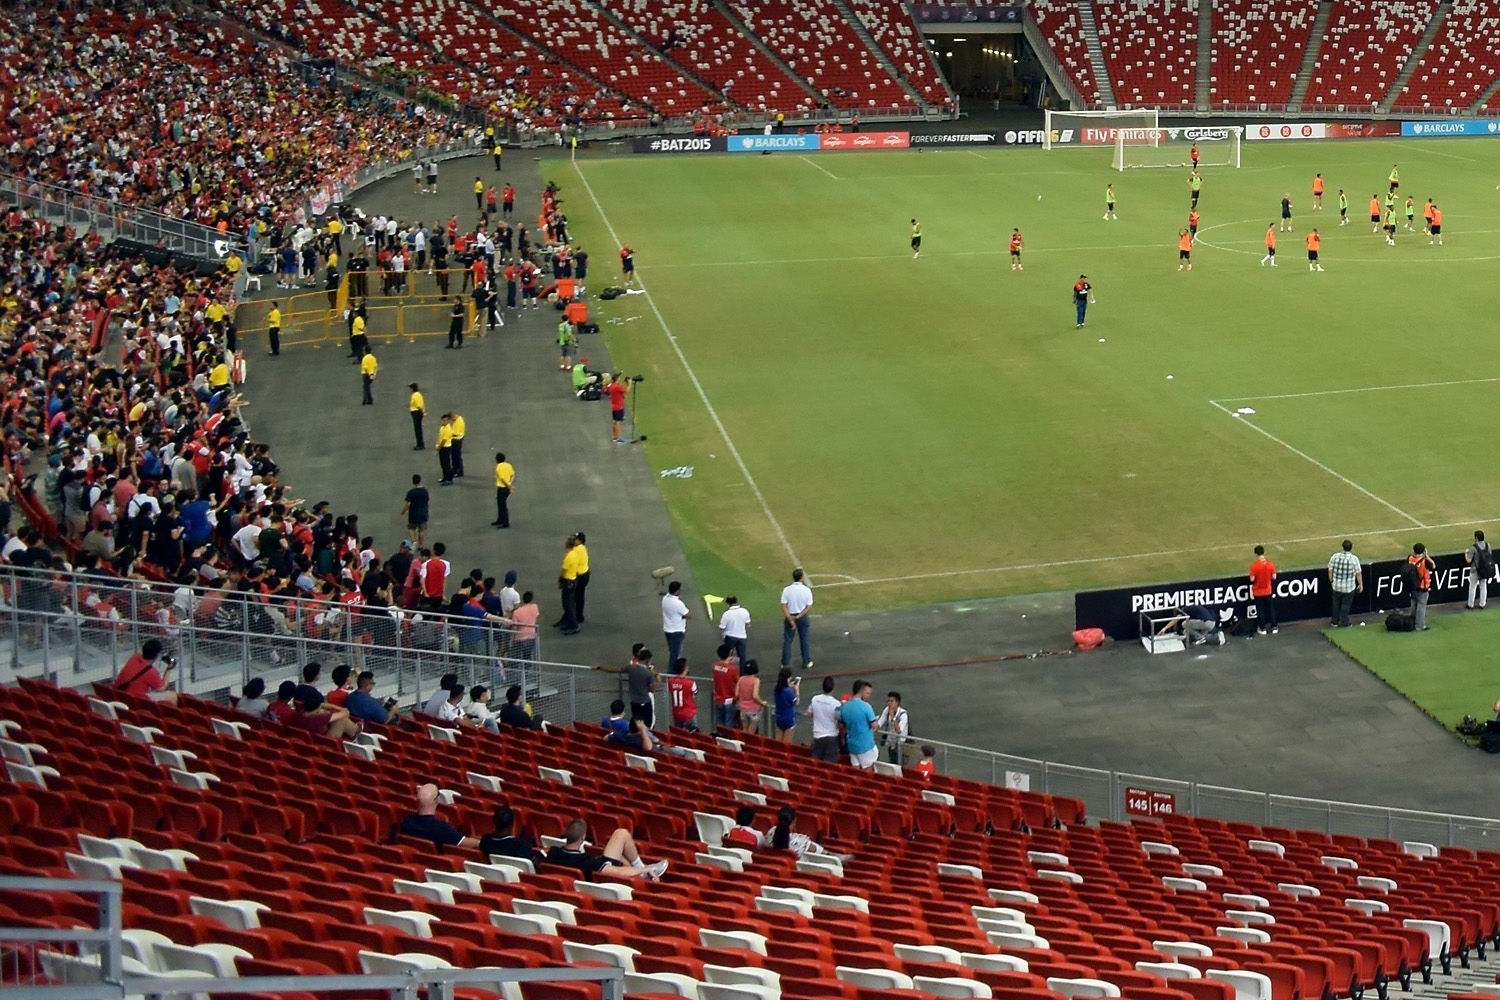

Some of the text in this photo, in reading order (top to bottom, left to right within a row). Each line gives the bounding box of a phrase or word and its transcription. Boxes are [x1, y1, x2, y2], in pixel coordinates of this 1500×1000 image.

[1184, 128, 1229, 141] Carlsberg
[1423, 123, 1465, 133] BARCLAYS
[755, 136, 806, 147] BARCLAYS
[1018, 130, 1045, 143] FIFA
[1087, 129, 1108, 141] Fly
[650, 138, 712, 151] #BAT2015
[1132, 577, 1318, 612] PREMIERLEAG.COM
[673, 690, 684, 708] 11
[1128, 798, 1148, 810] 145
[1153, 801, 1172, 814] 146
